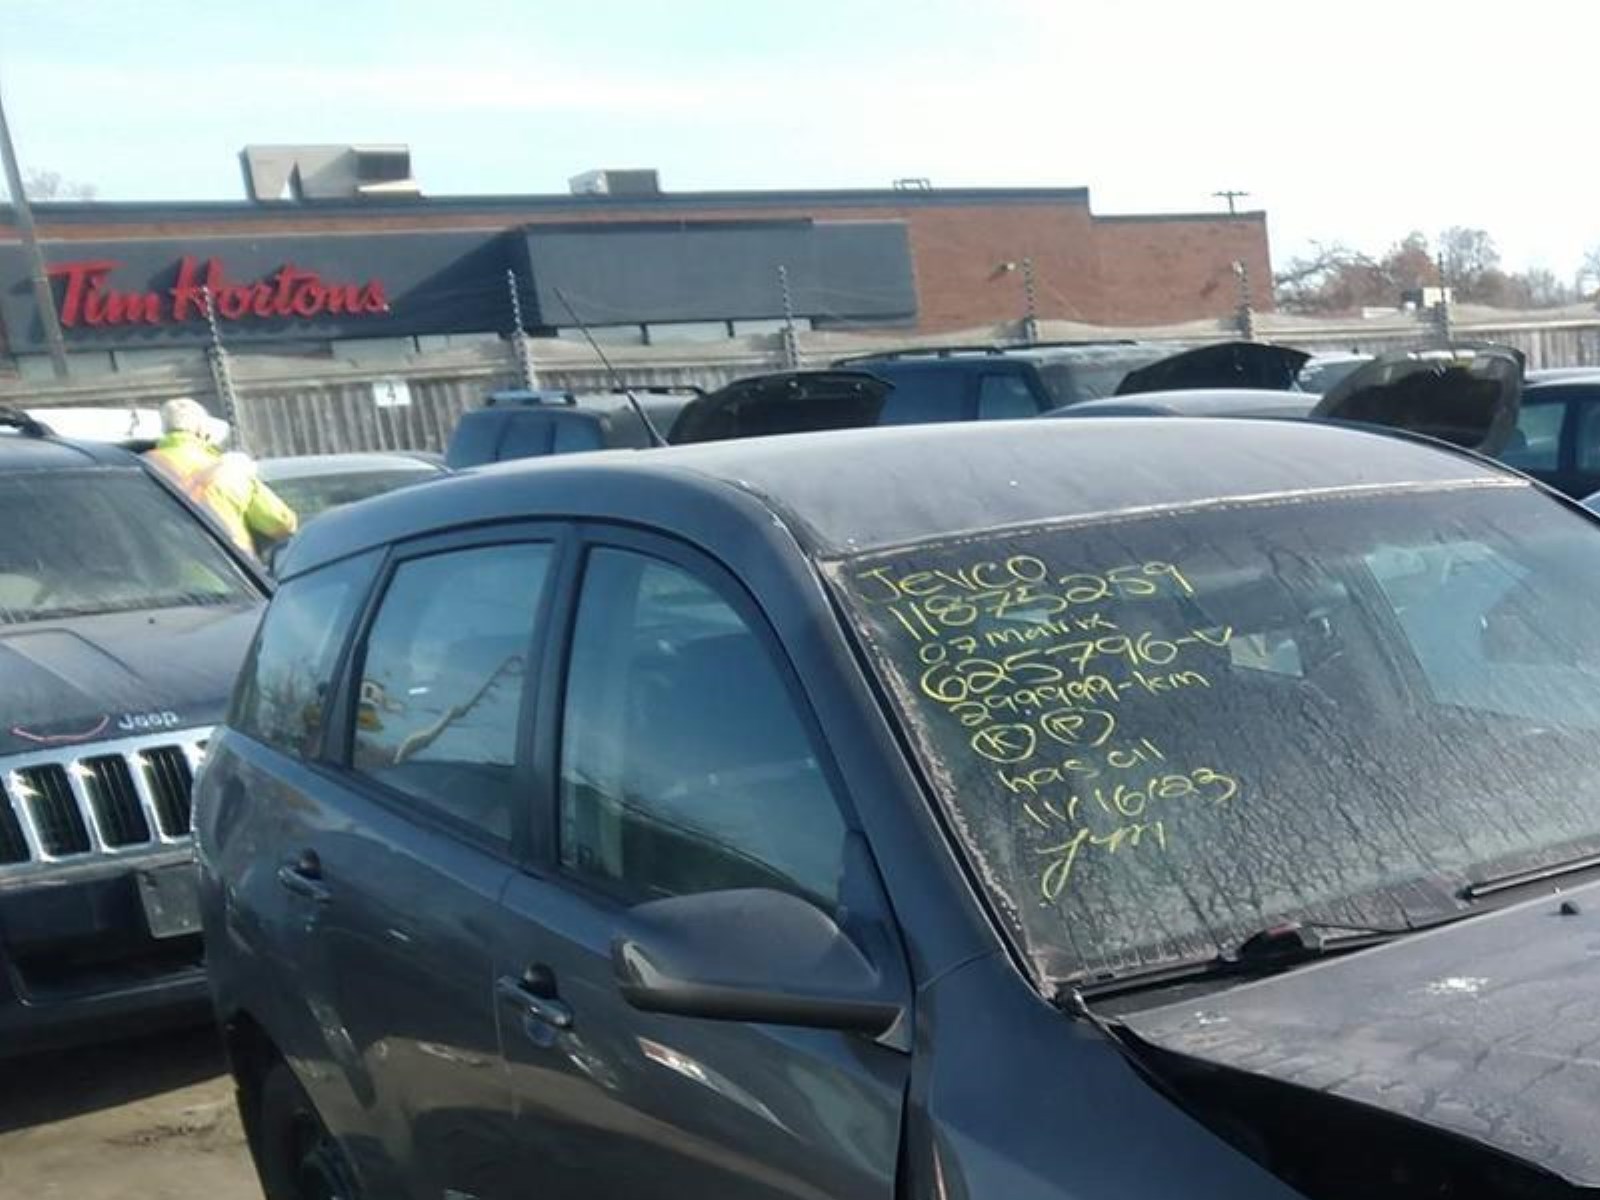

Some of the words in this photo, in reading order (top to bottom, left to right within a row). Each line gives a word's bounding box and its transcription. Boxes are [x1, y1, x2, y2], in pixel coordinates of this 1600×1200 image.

[46, 259, 162, 328] Tim
[171, 254, 389, 321] Hortons
[119, 711, 179, 730] Jeep
